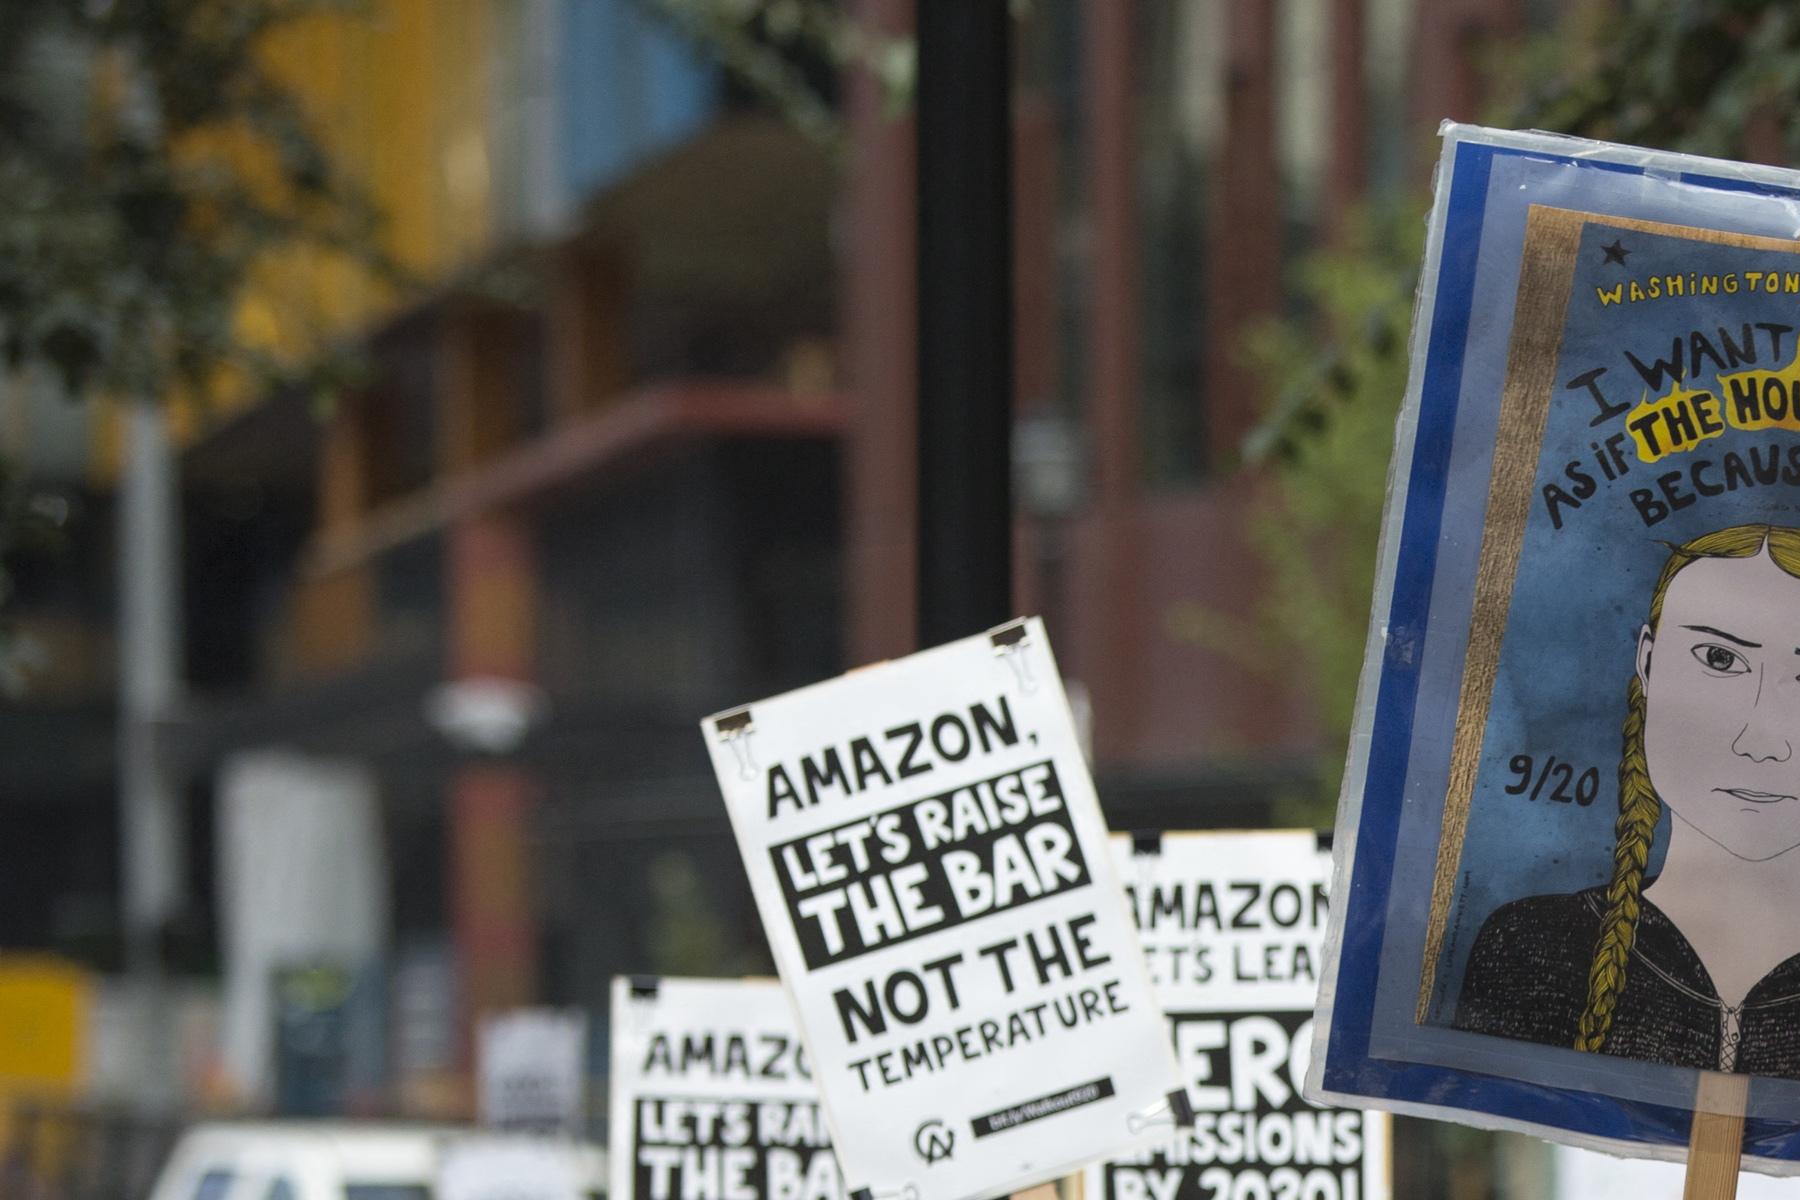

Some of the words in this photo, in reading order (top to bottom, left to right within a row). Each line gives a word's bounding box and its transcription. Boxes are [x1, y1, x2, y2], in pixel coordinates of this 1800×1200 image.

[1566, 367, 1628, 428] I
[1624, 322, 1793, 394] WANT
[1542, 460, 1597, 530] AS
[1632, 391, 1724, 460] THE
[767, 696, 1040, 820] AMAZON,
[1504, 753, 1600, 807] 9/20
[781, 815, 911, 893] LET'S
[913, 767, 1063, 851] RAISE
[798, 862, 945, 957] THE
[941, 821, 1082, 920] BAR
[833, 953, 964, 1044] NOT
[978, 913, 1111, 995] THE
[1233, 944, 1315, 982] LEA
[848, 979, 1129, 1091] TEMPERATURE
